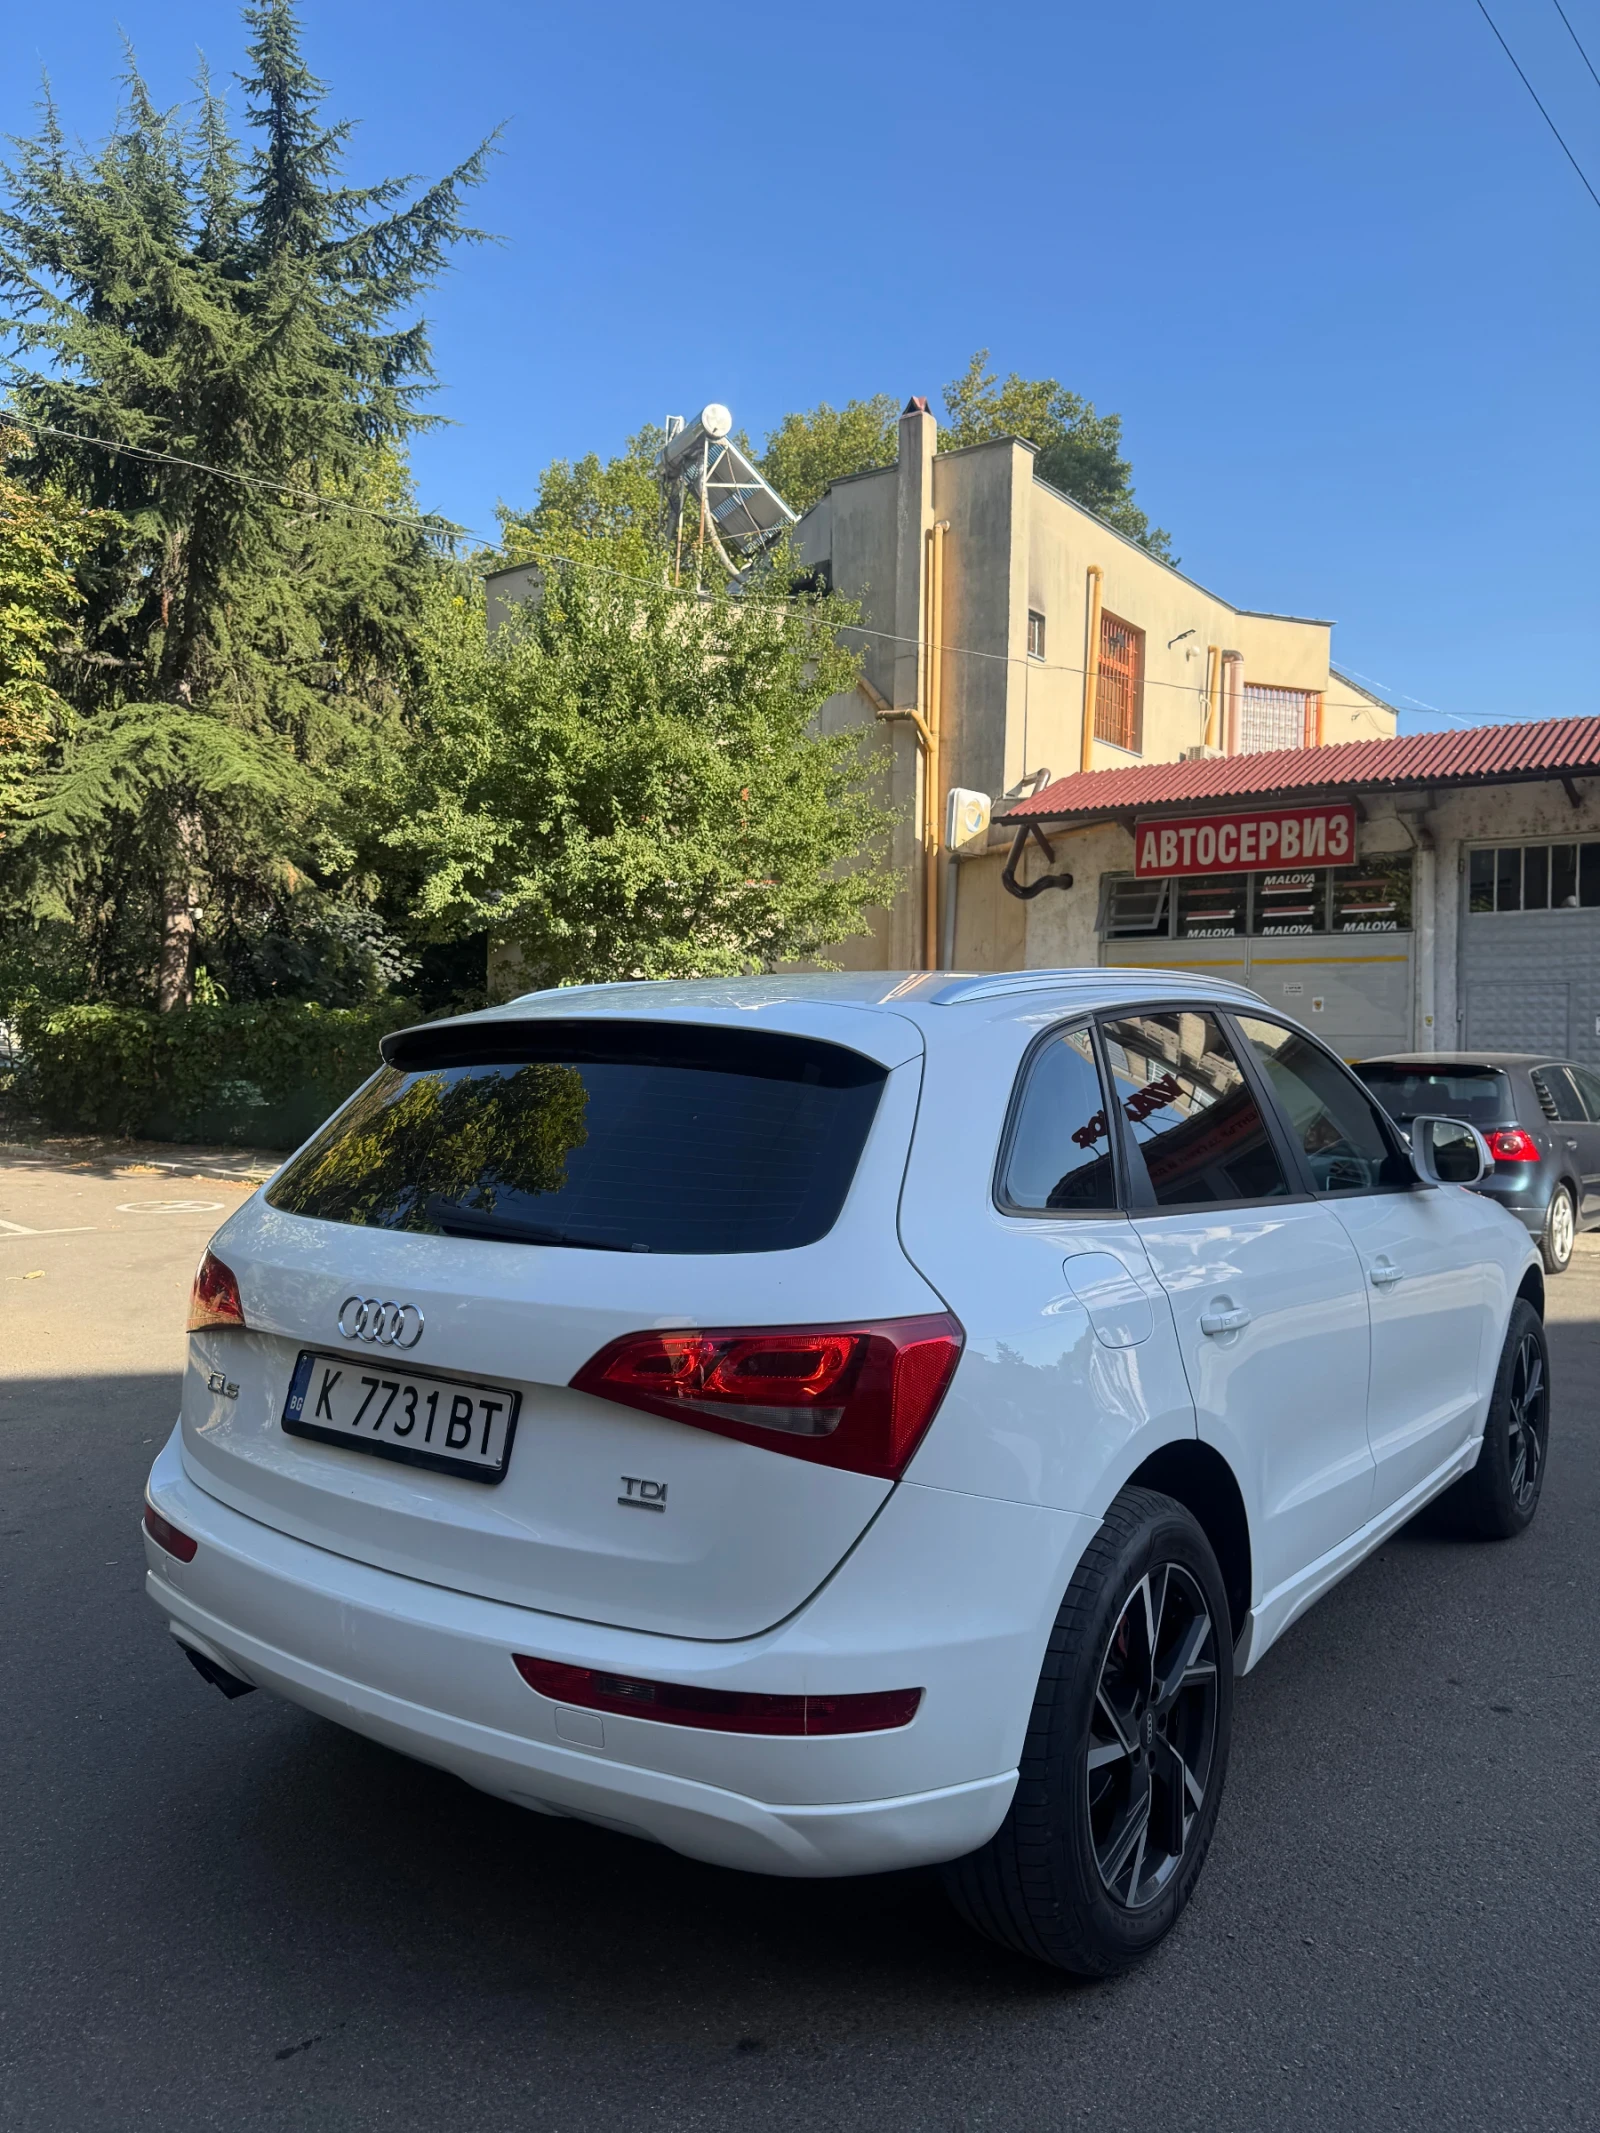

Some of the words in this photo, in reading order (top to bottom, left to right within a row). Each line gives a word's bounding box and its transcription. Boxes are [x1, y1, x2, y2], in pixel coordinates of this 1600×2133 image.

[1140, 815, 1349, 868] АВТОСЕРВИЗ
[1264, 873, 1316, 886] MALOYA
[1187, 928, 1236, 938] MALOYA
[1262, 925, 1313, 936] MALOYA
[1343, 921, 1397, 933] MALOYA
[289, 1396, 304, 1411] BG
[620, 1476, 668, 1502] TDI
